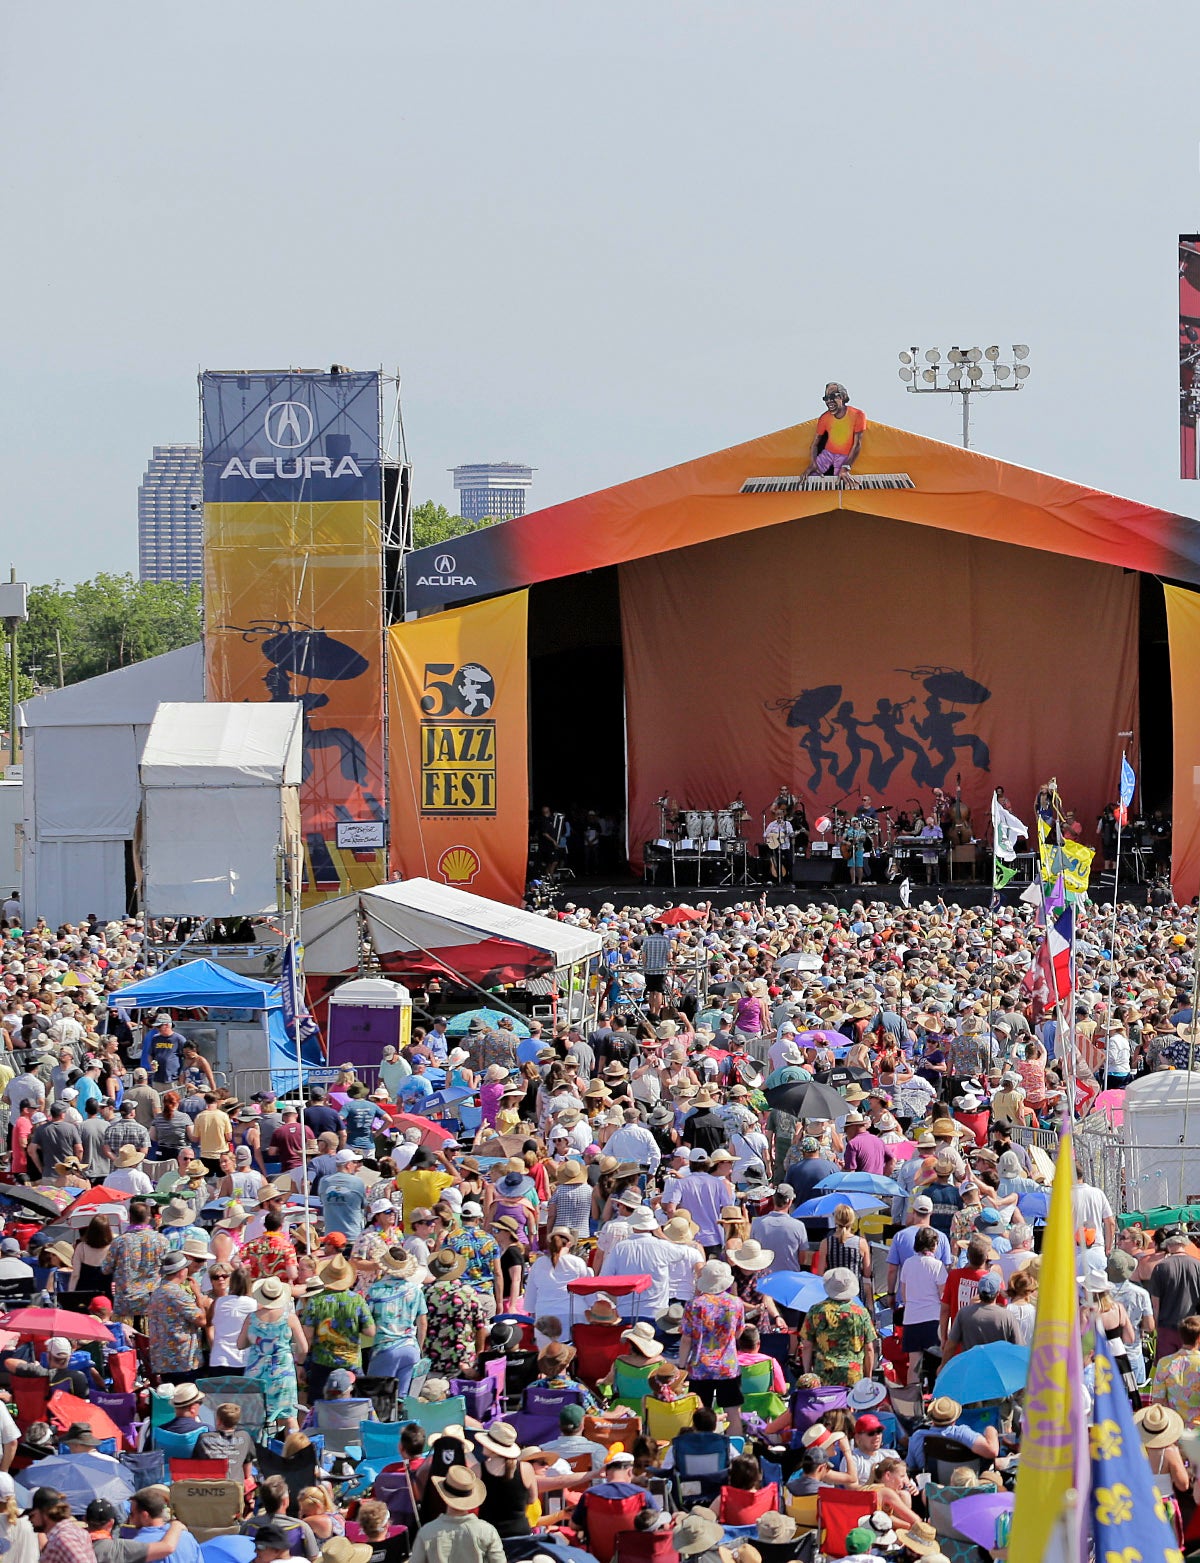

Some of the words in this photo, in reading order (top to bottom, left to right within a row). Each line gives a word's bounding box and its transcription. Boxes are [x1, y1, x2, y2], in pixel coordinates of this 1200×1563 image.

[220, 456, 363, 479] ACURA
[416, 576, 477, 586] ACURA
[421, 663, 495, 717] 50
[424, 729, 494, 766] JAZZ
[425, 772, 495, 806] FEST
[187, 1488, 226, 1497] SAINTS
